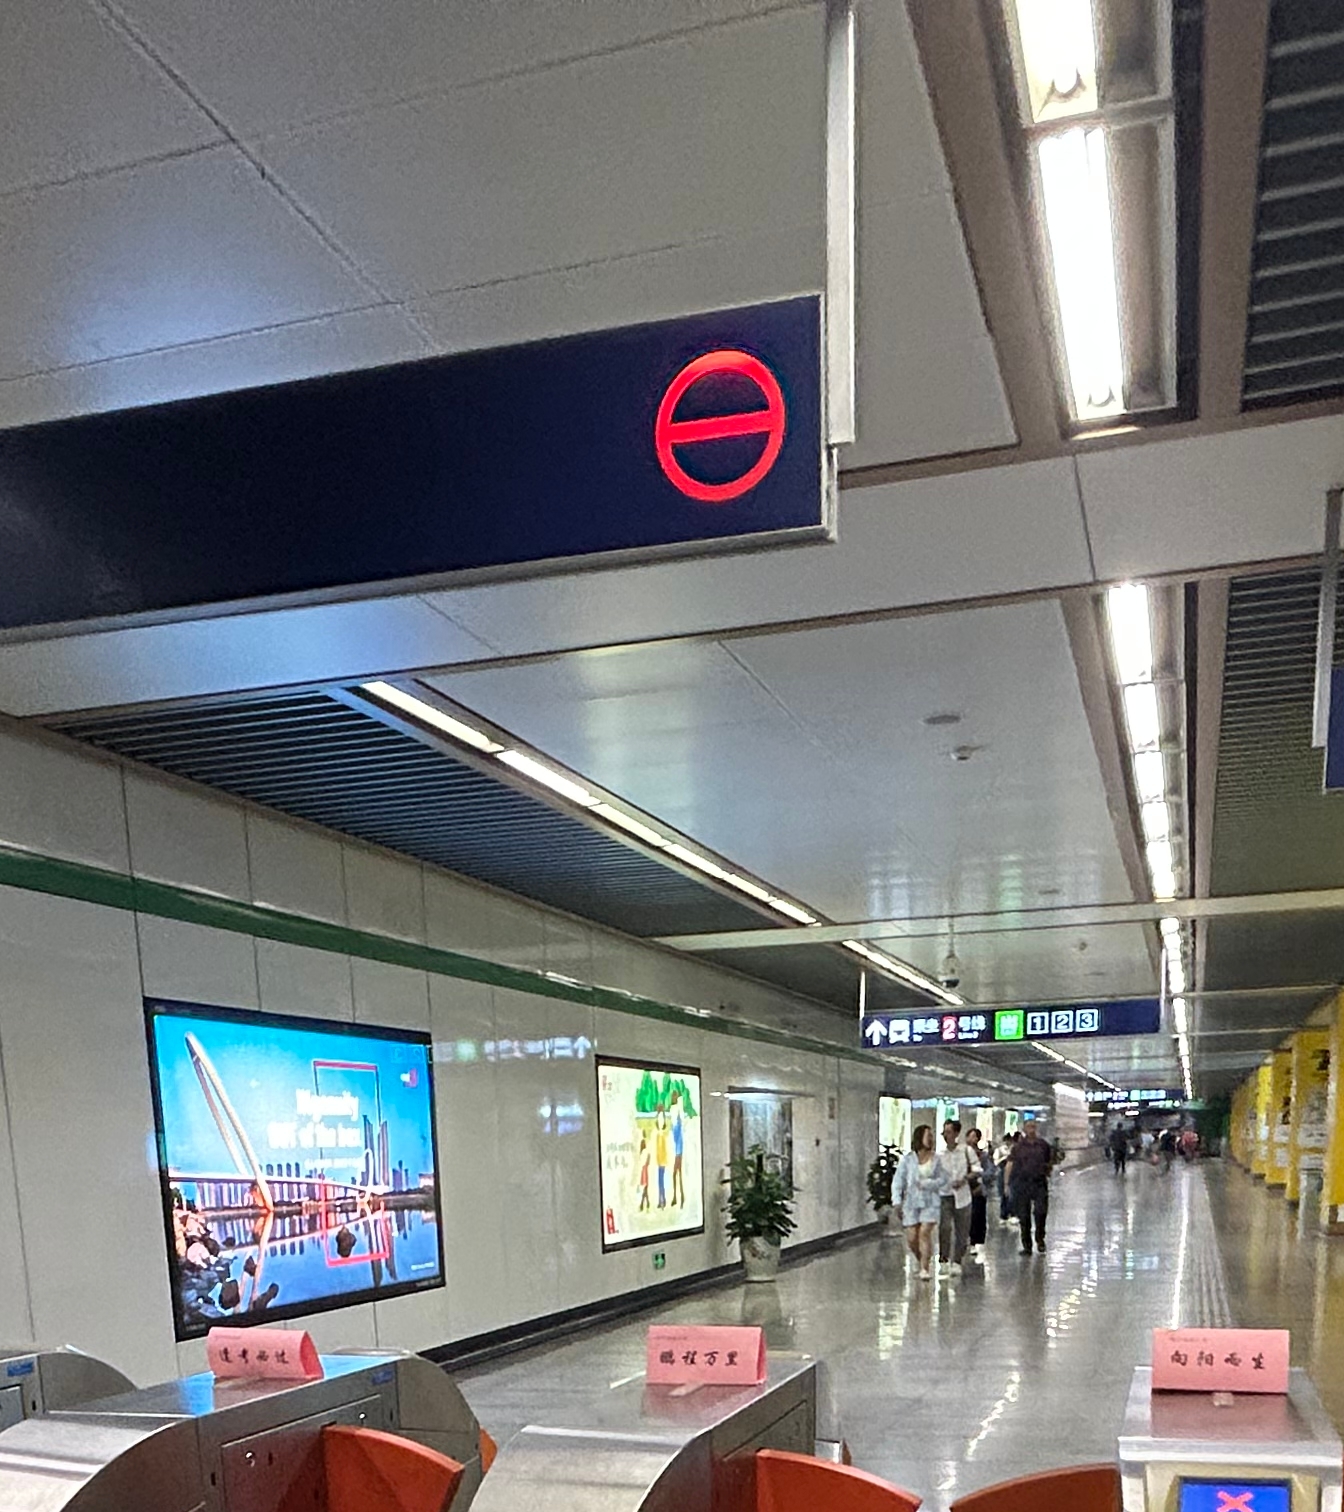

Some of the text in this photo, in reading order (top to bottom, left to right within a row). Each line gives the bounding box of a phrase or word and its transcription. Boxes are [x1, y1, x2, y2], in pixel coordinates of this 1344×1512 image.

[942, 1018, 956, 1040] 2
[659, 1349, 738, 1366] 鹏程万里
[1170, 1349, 1266, 1370] 向阳而生
